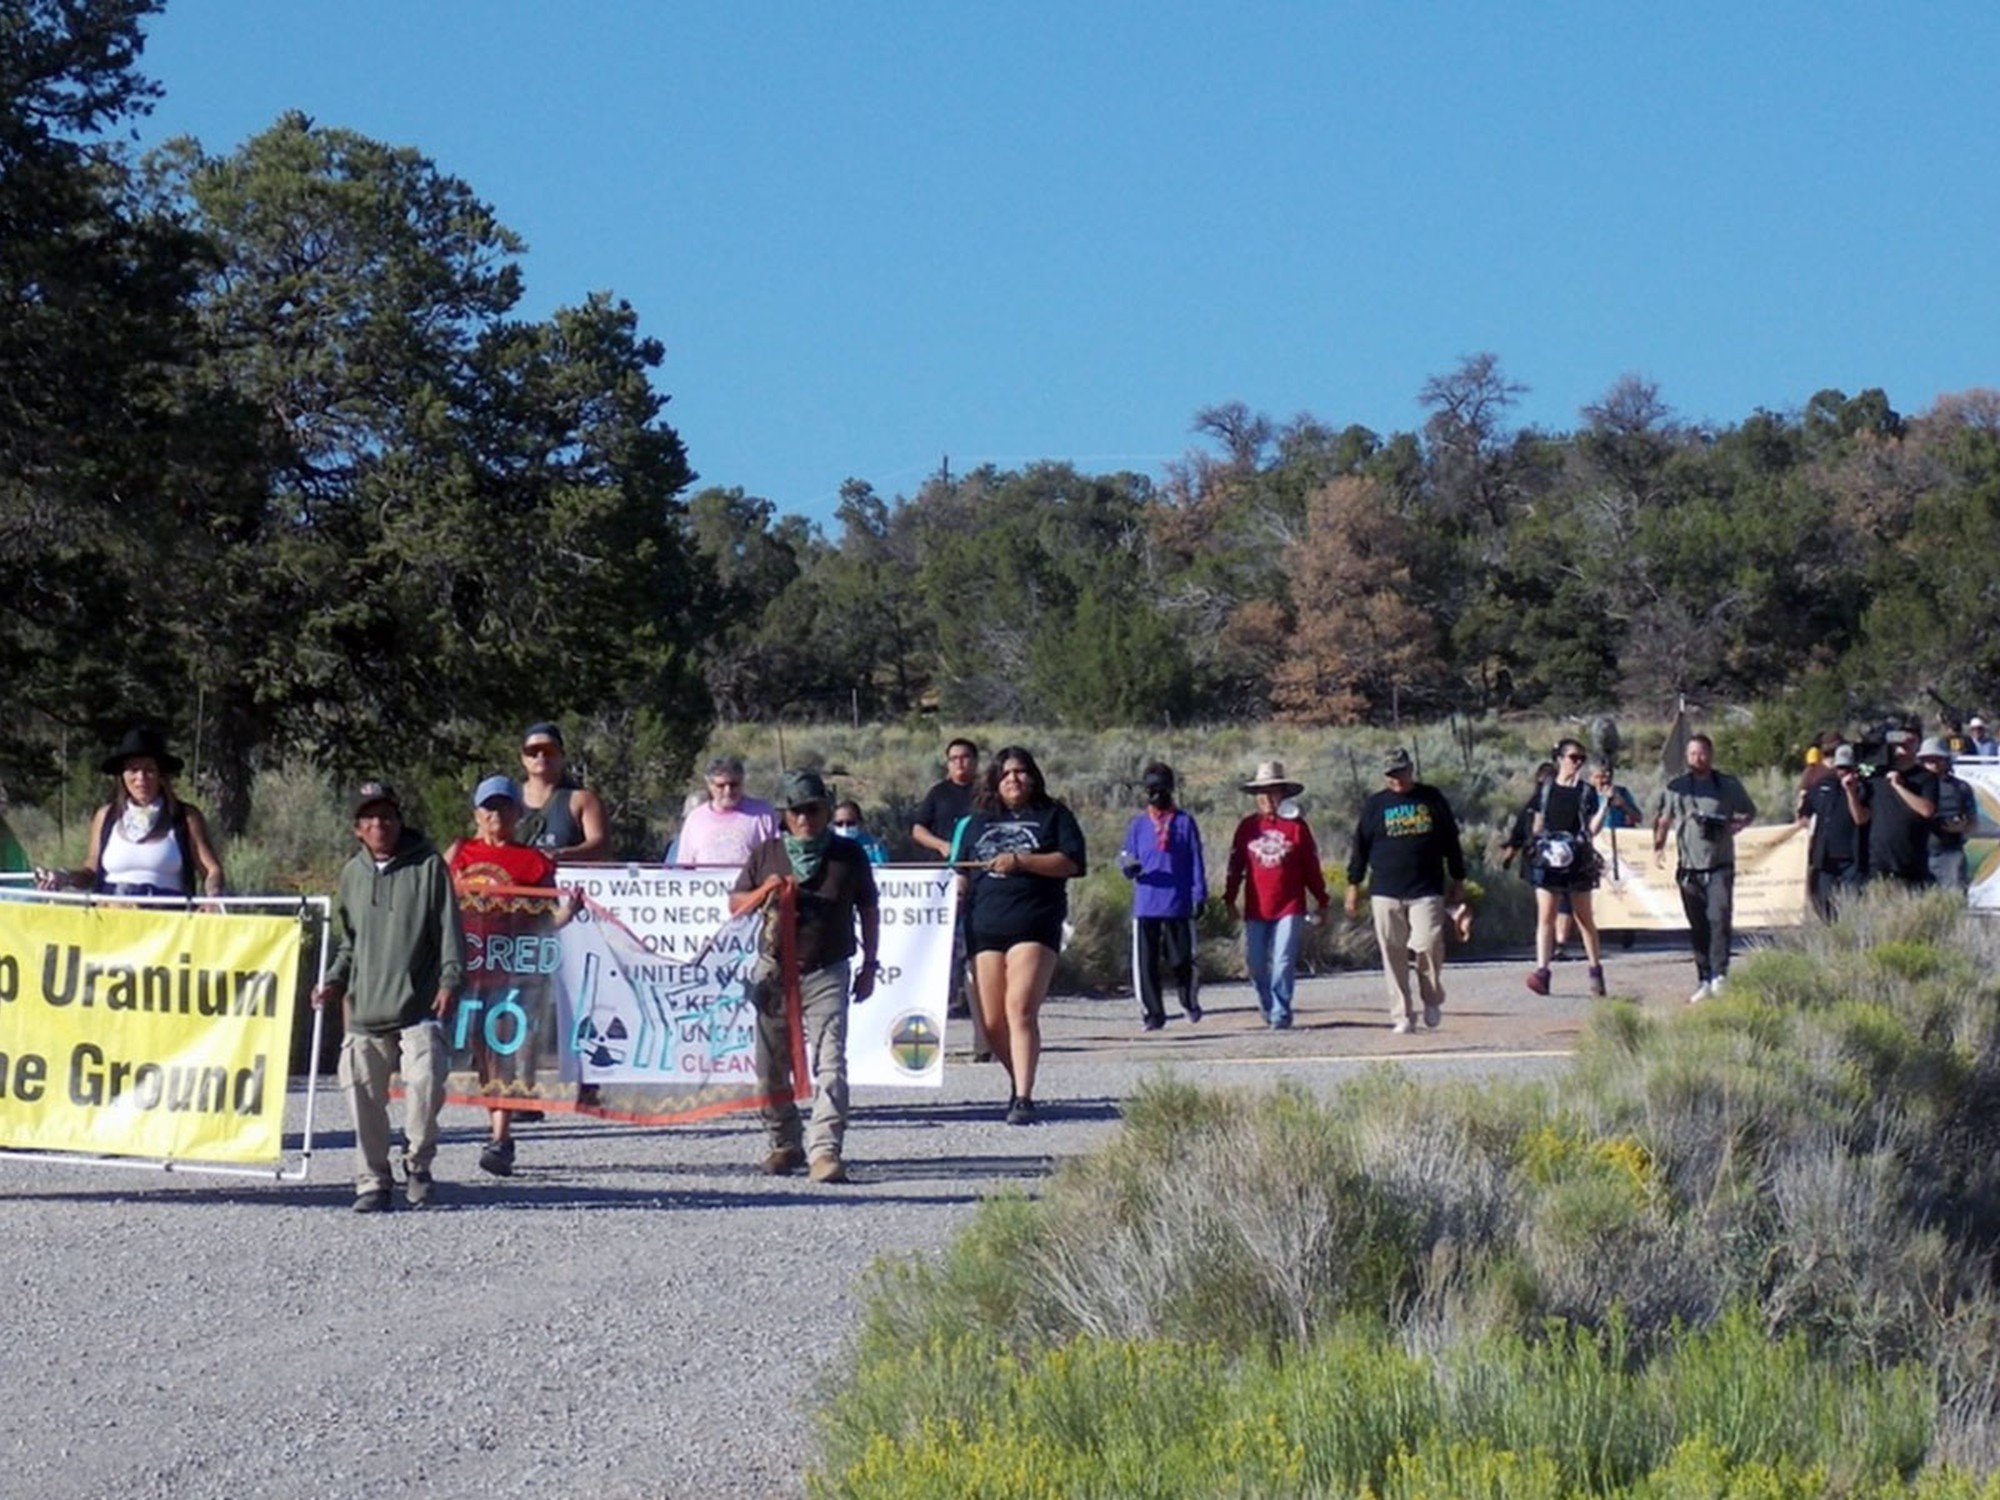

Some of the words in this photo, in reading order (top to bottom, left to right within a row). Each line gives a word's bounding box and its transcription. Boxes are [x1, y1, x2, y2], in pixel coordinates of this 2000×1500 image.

[609, 880, 683, 898] WATER
[630, 908, 656, 924] TO
[903, 907, 949, 925] SITE
[42, 944, 278, 1017] Uranium
[624, 964, 709, 984] UNITED
[69, 1042, 266, 1115] Ground
